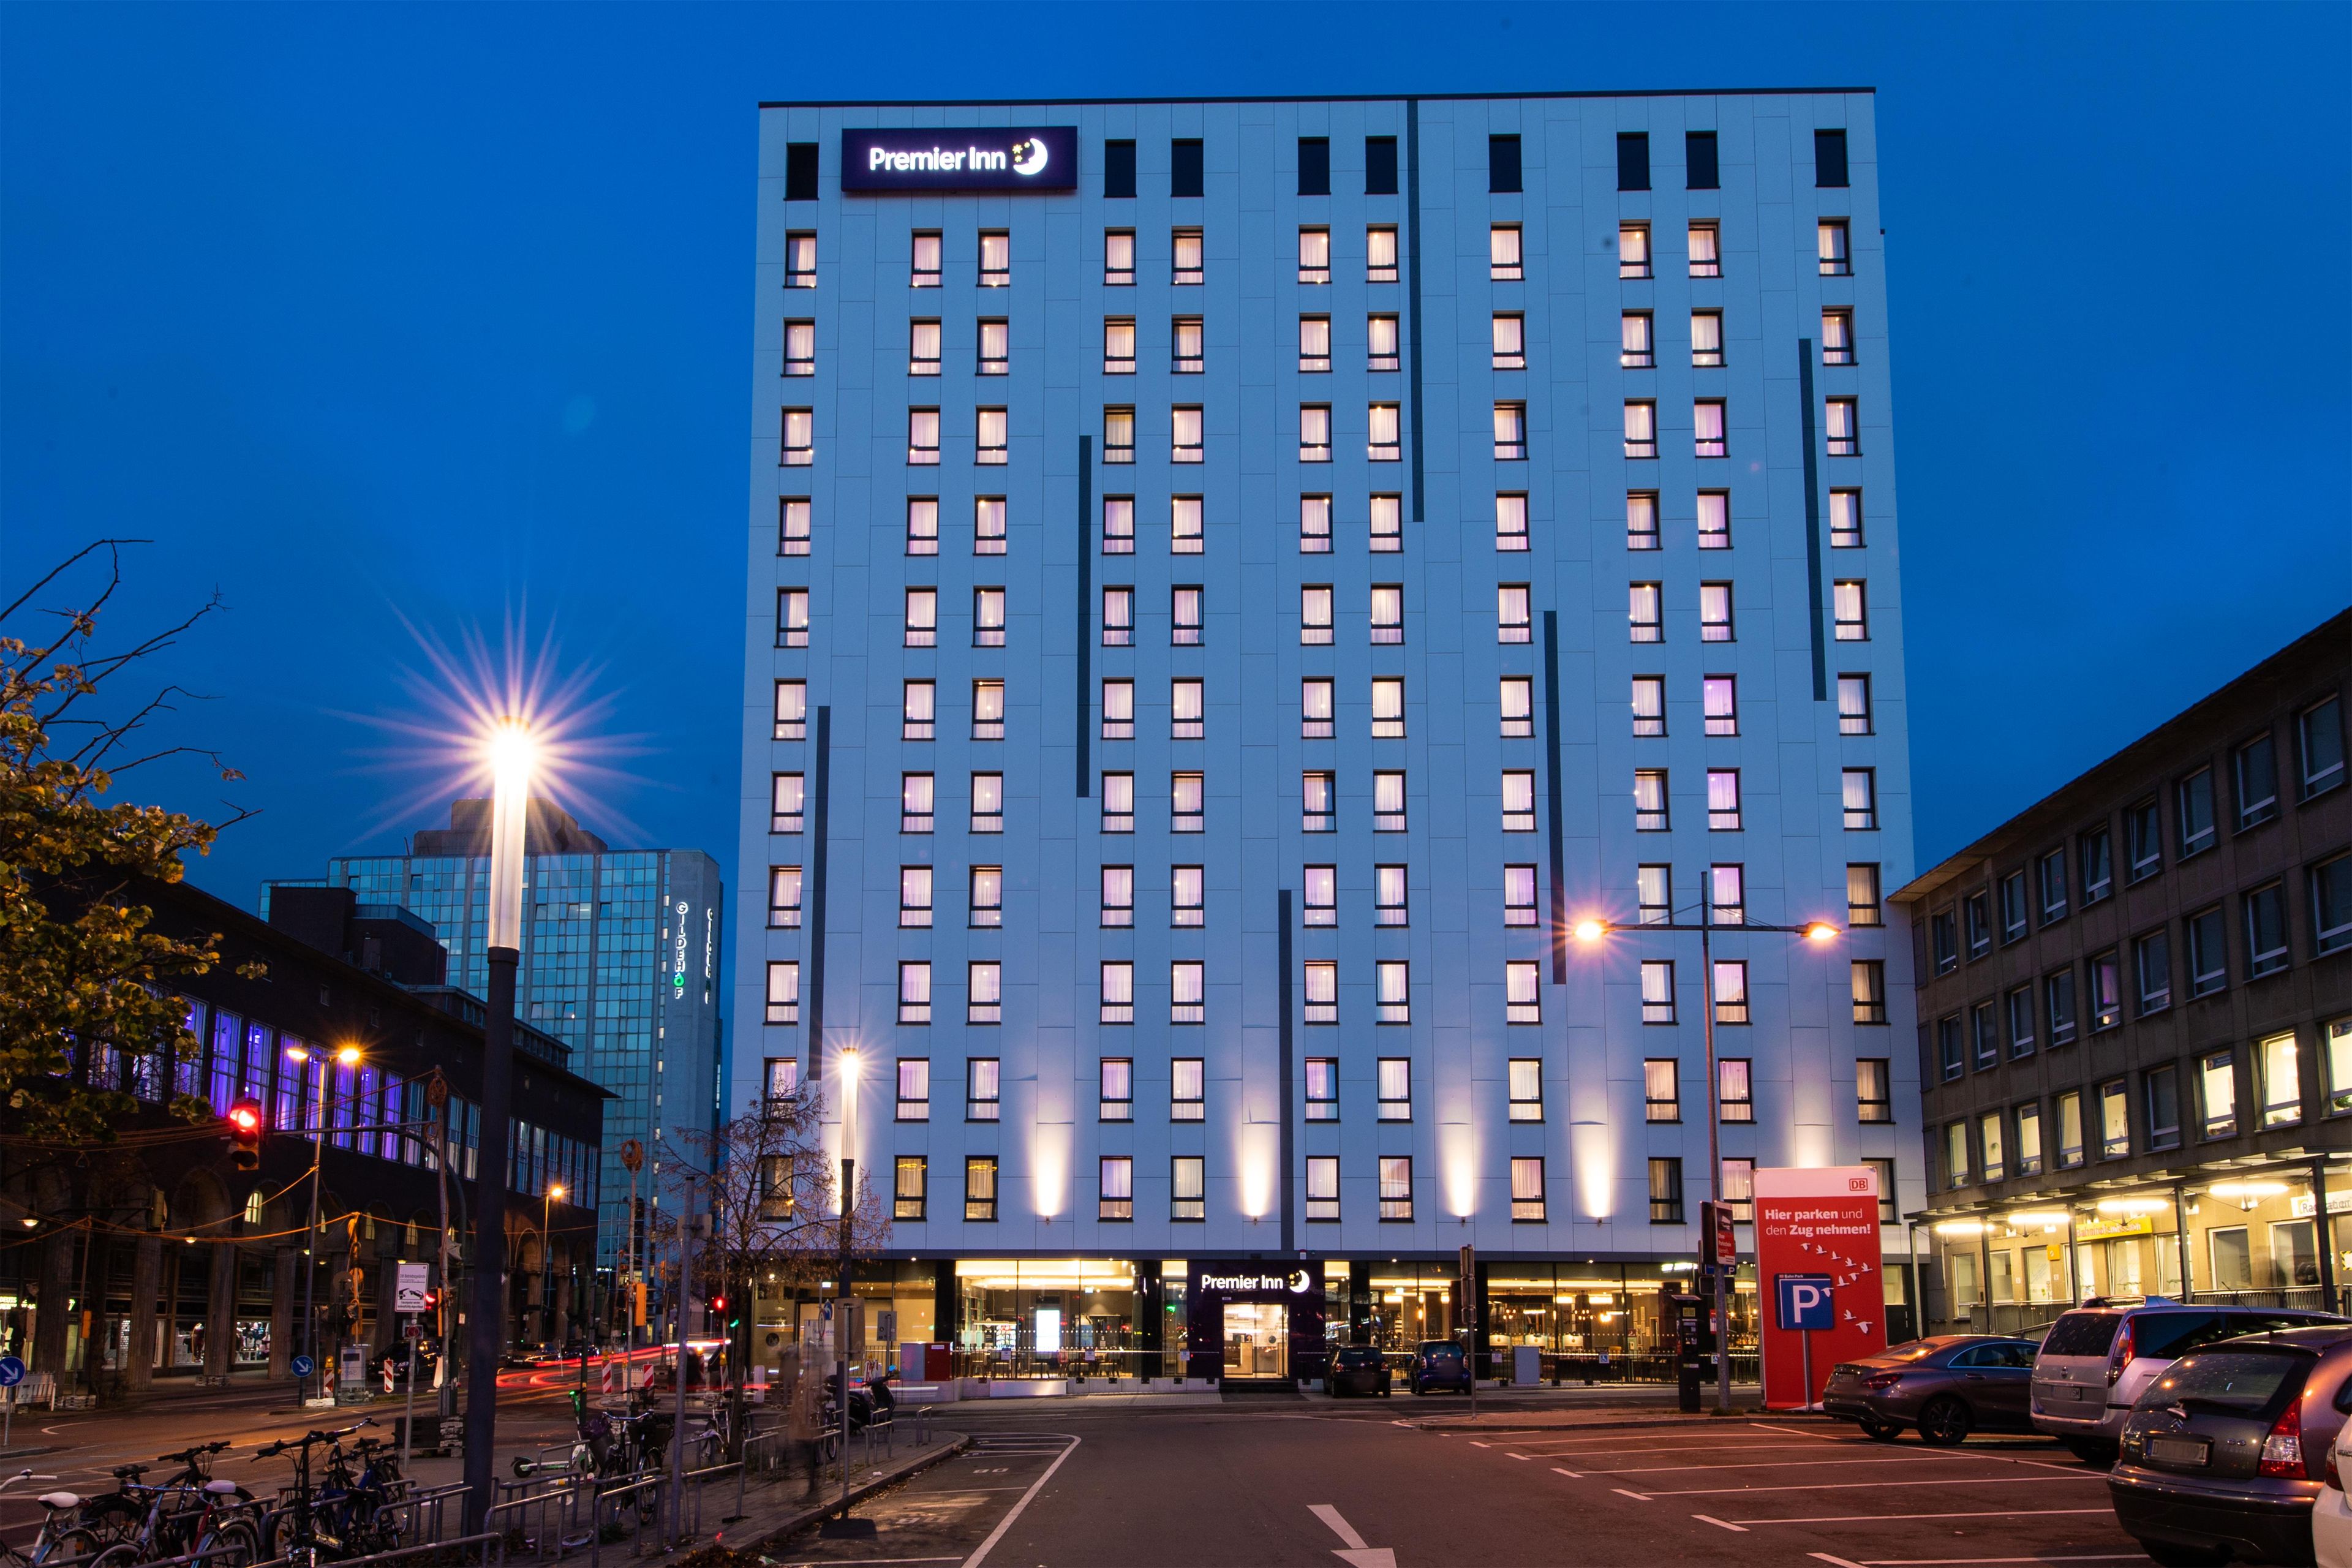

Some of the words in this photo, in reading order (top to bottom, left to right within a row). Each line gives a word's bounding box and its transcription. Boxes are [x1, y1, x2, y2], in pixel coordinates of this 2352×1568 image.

[870, 146, 966, 170] Premier
[970, 146, 1006, 170] Inn
[674, 902, 688, 1000] GILDEHOF
[1852, 1180, 1866, 1189] DB
[1765, 1209, 1792, 1219] Hier
[1795, 1208, 1838, 1222] parken
[1841, 1208, 1863, 1219] und
[1766, 1226, 1787, 1235] den
[1789, 1225, 1814, 1237] Zug
[1816, 1224, 1871, 1235] nehmen!
[1202, 1275, 1259, 1289] Premier
[1261, 1275, 1283, 1289] Inn
[1793, 1285, 1820, 1323] P
